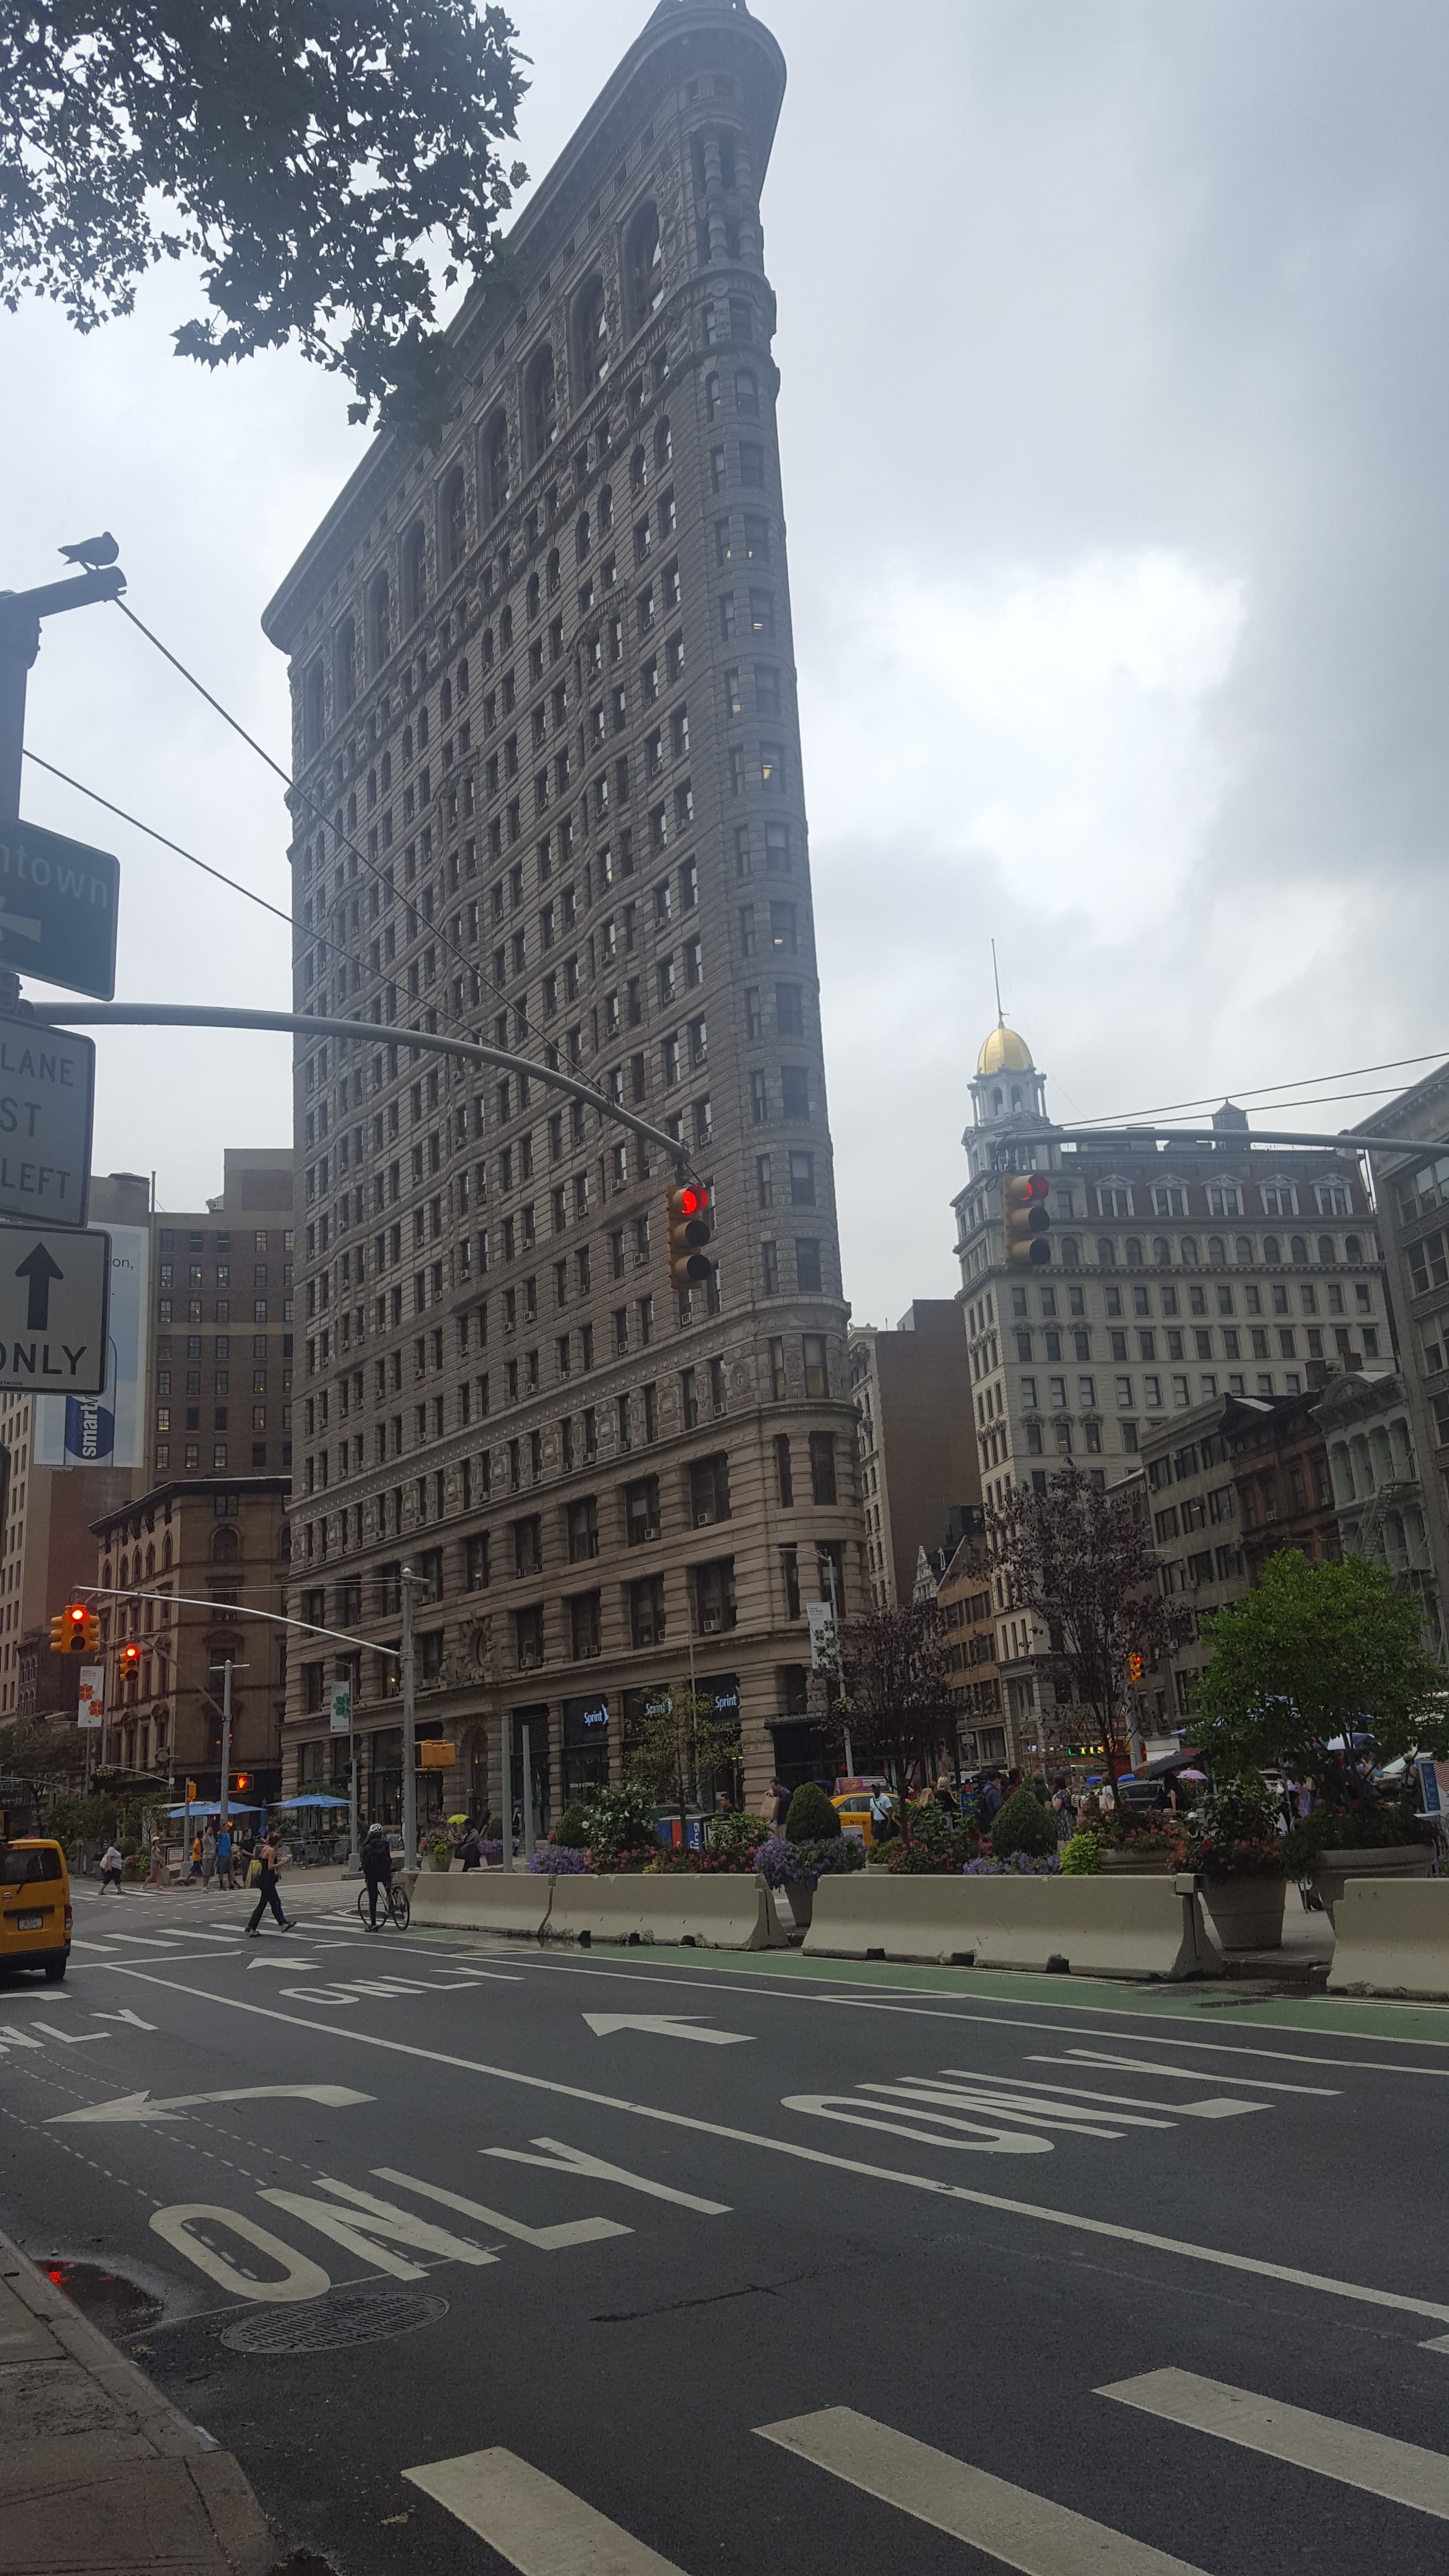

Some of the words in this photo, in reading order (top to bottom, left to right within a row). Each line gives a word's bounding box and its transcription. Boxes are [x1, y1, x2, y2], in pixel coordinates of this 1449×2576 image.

[0, 1042, 75, 1087] LANE
[0, 1096, 42, 1137] ST
[0, 1158, 70, 1199] LEFT
[0, 1342, 87, 1375] NLY
[584, 1711, 602, 1726] Sprint
[715, 1694, 737, 1711] Sprint
[278, 1966, 526, 2005] ONLY
[780, 2049, 1345, 2153] ONLY
[149, 2137, 734, 2302] ONLY
